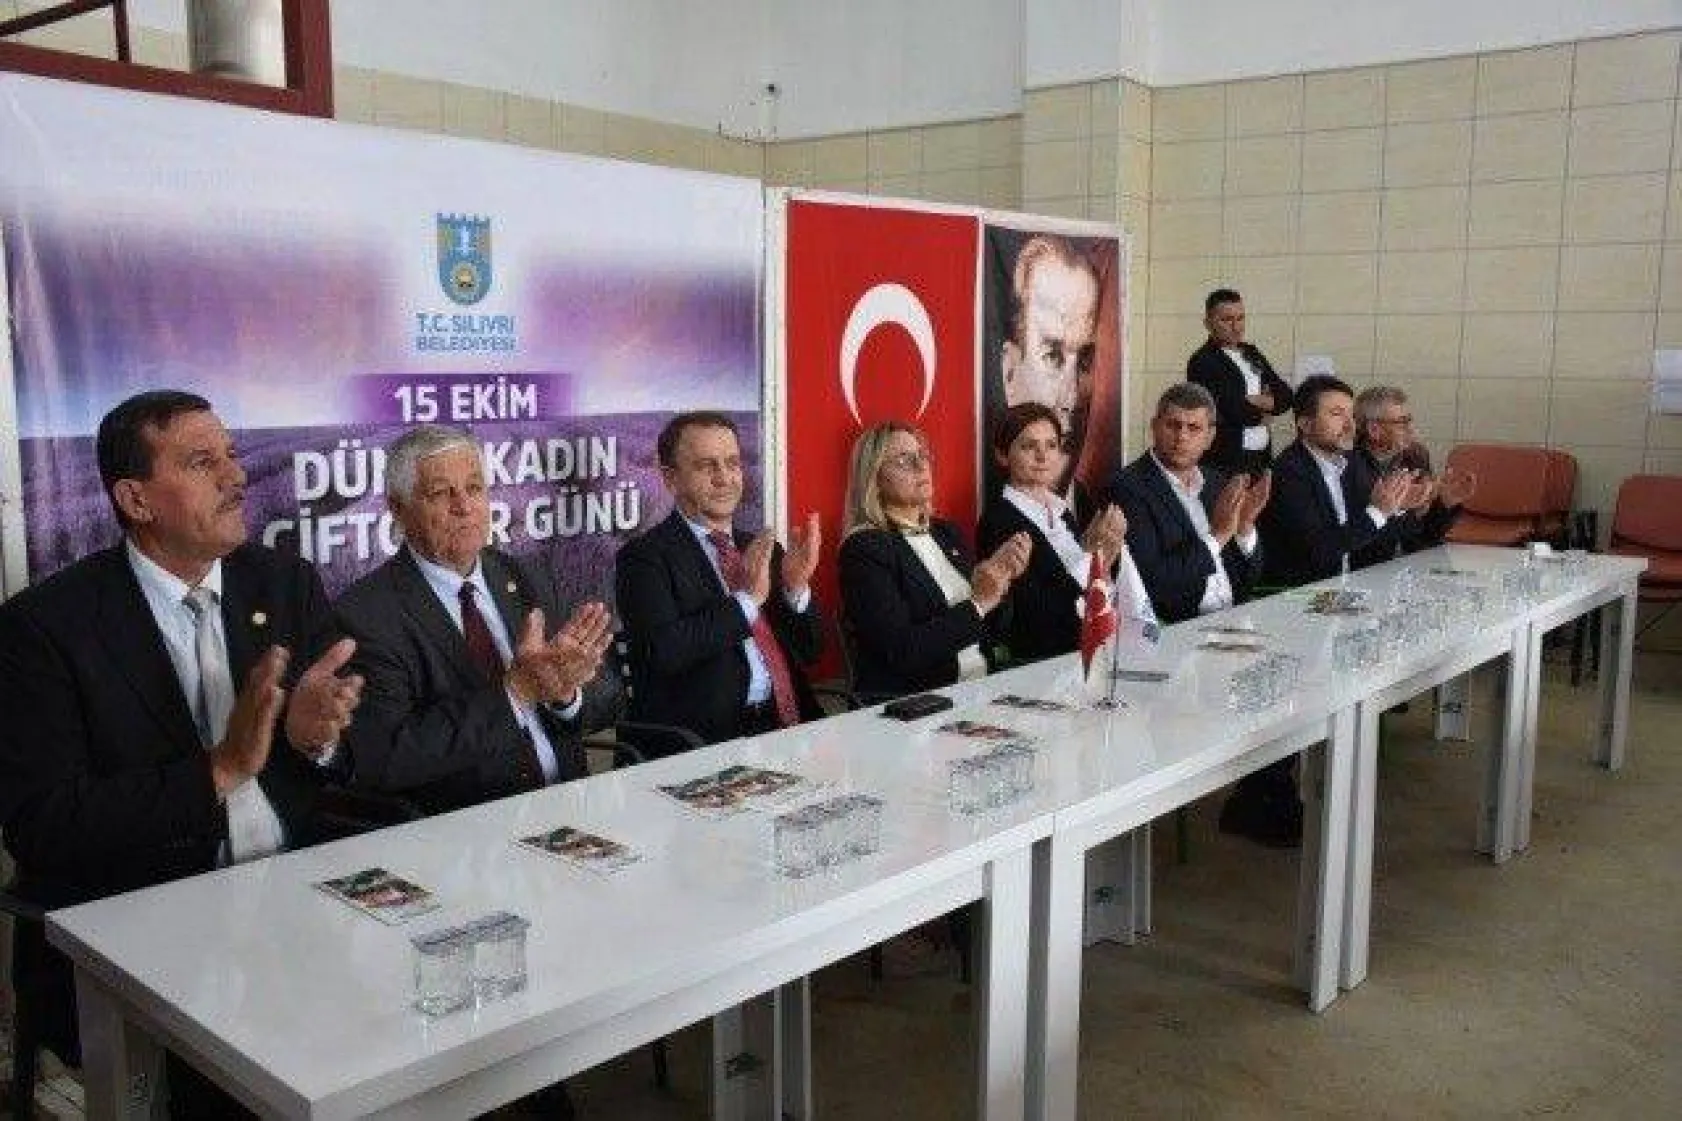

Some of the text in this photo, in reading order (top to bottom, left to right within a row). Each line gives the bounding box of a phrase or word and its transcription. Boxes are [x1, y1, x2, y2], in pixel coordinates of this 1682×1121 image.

[394, 376, 538, 422] 15 EKİM
[484, 436, 617, 485] KADIN
[526, 481, 641, 540] GÜNÜ
